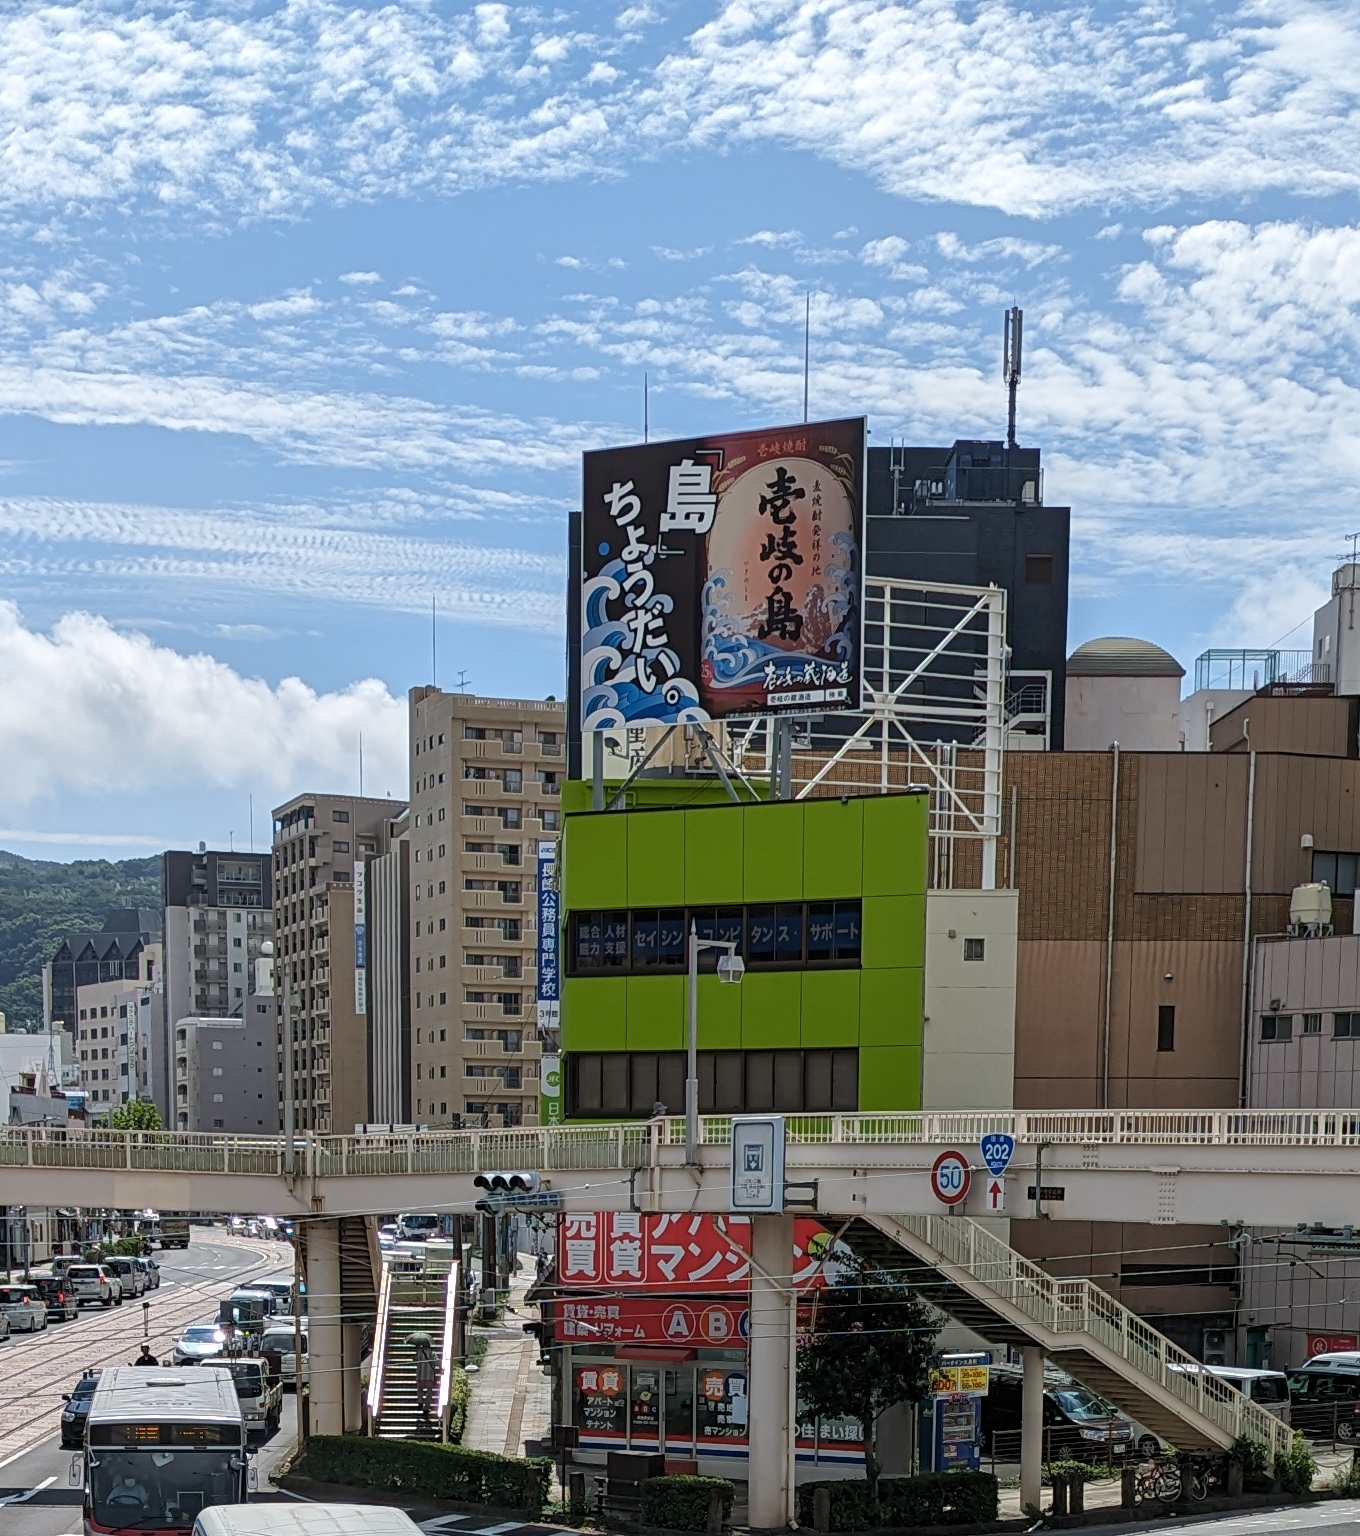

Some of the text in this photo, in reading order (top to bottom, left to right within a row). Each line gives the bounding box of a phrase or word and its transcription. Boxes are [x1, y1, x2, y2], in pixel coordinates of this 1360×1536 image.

[756, 438, 808, 454] 壱岐焼酎
[810, 479, 823, 577] 麦焼酎発祥の地
[757, 466, 806, 642] 壱岐の島
[541, 862, 557, 997] 長崎公務員専門学校
[985, 1143, 1010, 1160] 202
[939, 1166, 962, 1189] 50
[580, 1371, 621, 1393] 賃貸
[705, 1377, 747, 1396] 売買
[582, 1407, 617, 1418] マンション
[585, 1419, 613, 1430] テナント
[703, 1426, 747, 1437] 売マンション
